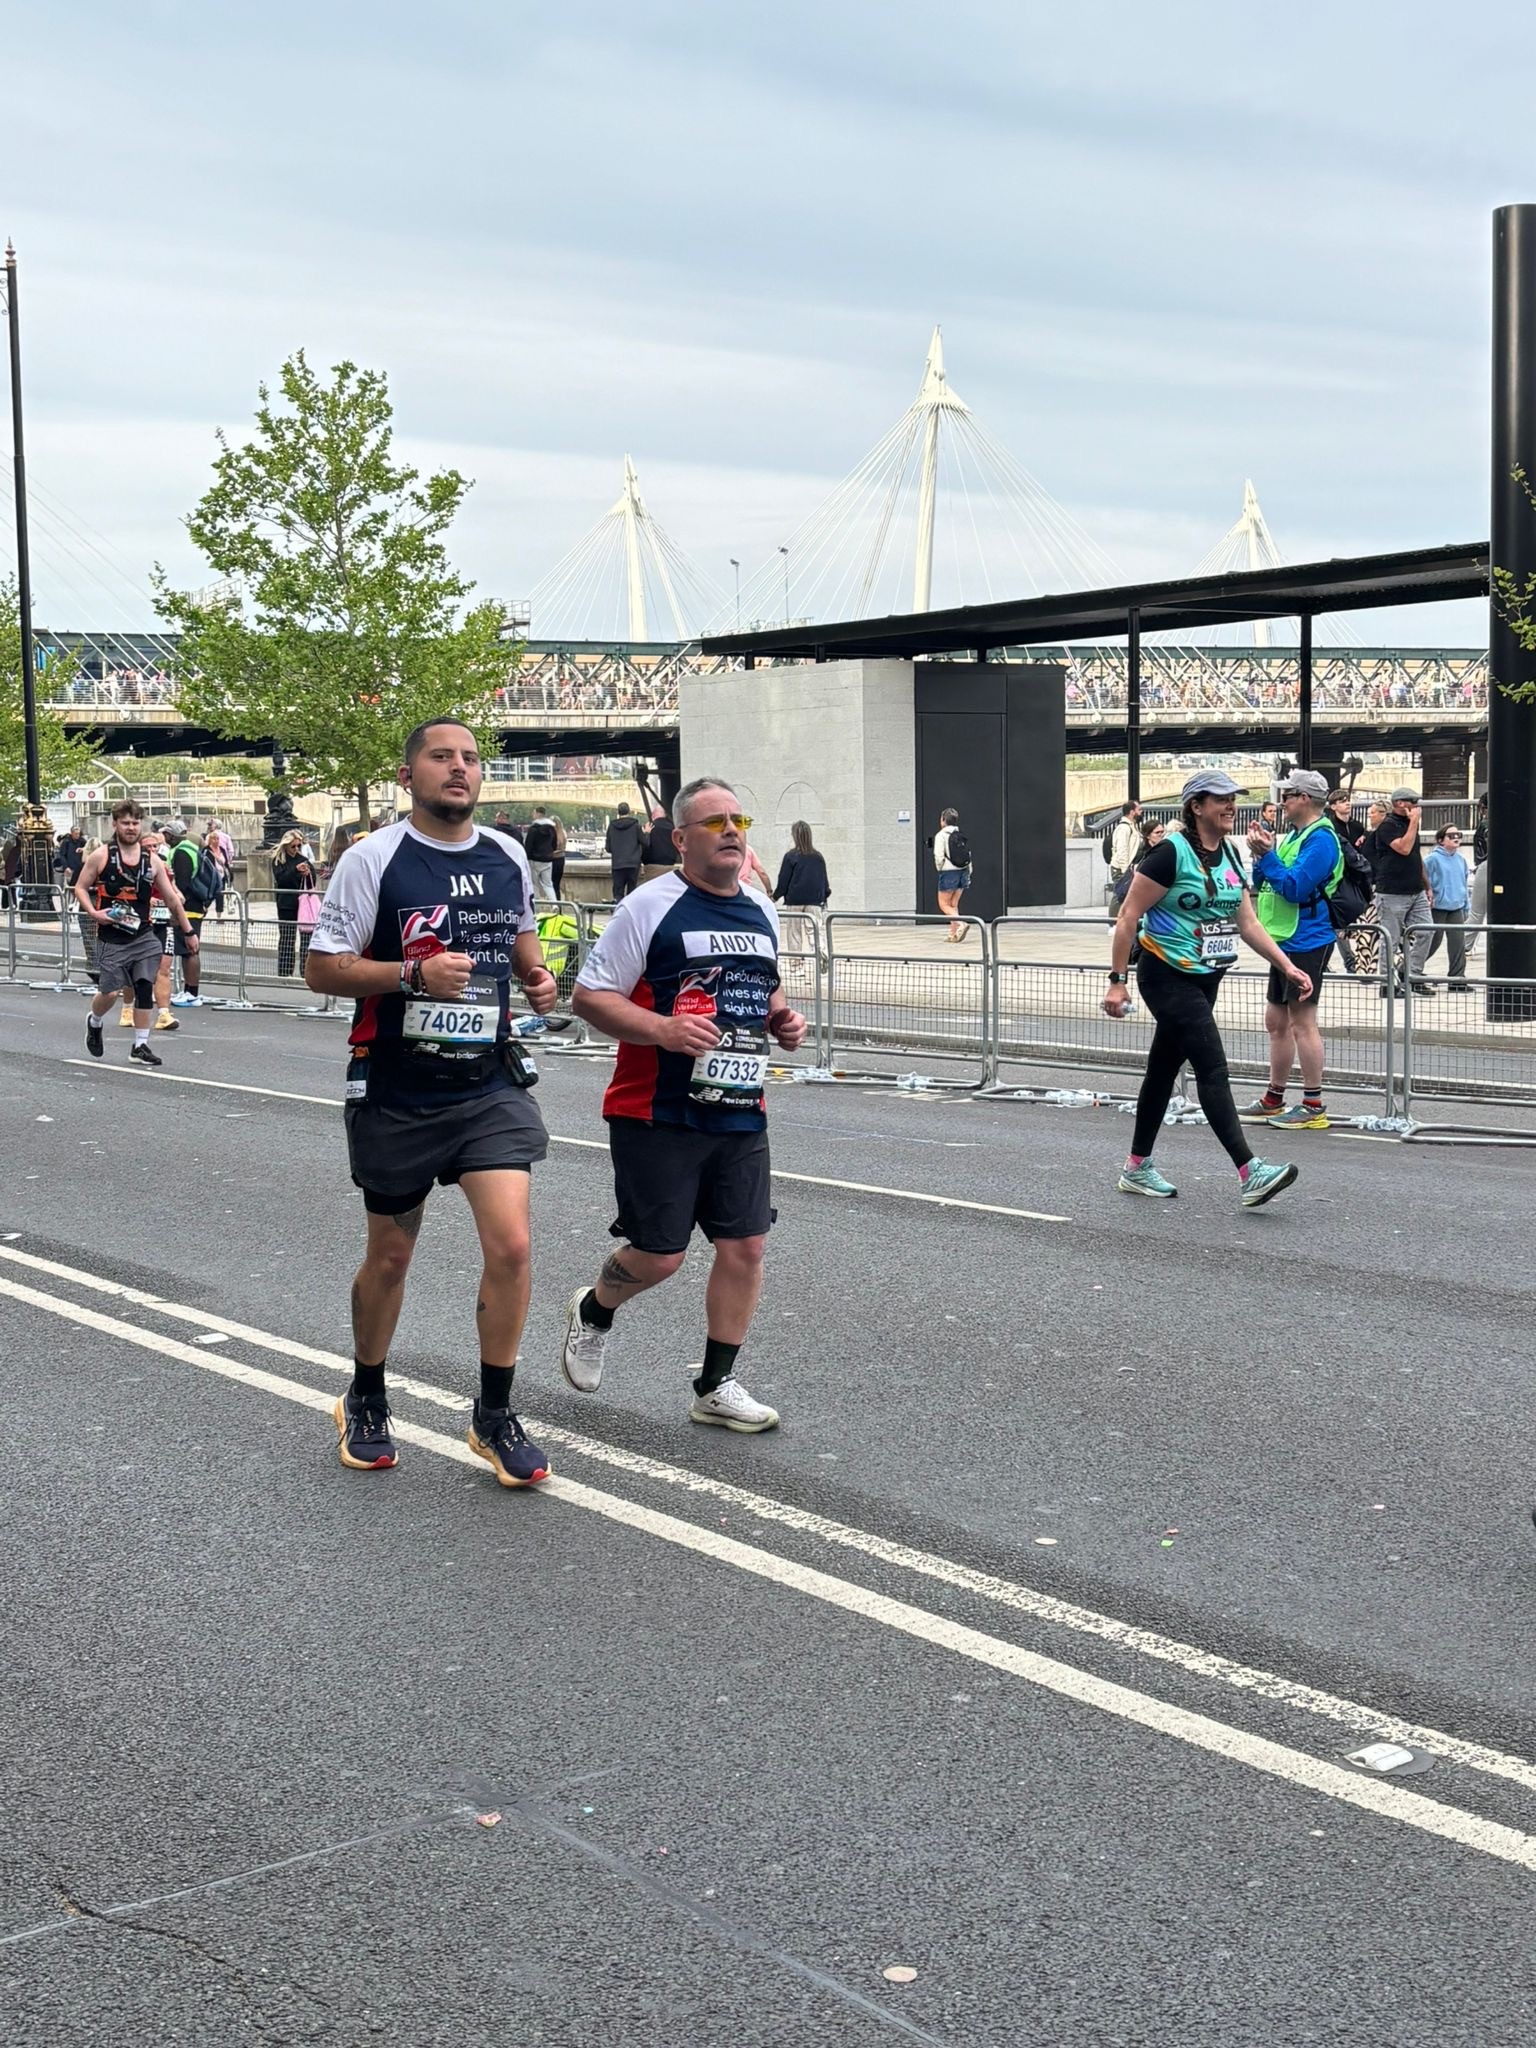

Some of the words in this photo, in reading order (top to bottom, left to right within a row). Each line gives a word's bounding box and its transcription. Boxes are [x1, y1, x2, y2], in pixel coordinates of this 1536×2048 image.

[450, 874, 484, 897] JAY
[458, 909, 520, 926] Rebuildin
[493, 929, 516, 945] afte
[709, 934, 758, 953] ANDY
[464, 949, 492, 963] ight
[722, 989, 750, 999] lives
[724, 1001, 755, 1016] sight
[419, 1010, 484, 1034] 74026
[707, 1057, 760, 1082] 67332
